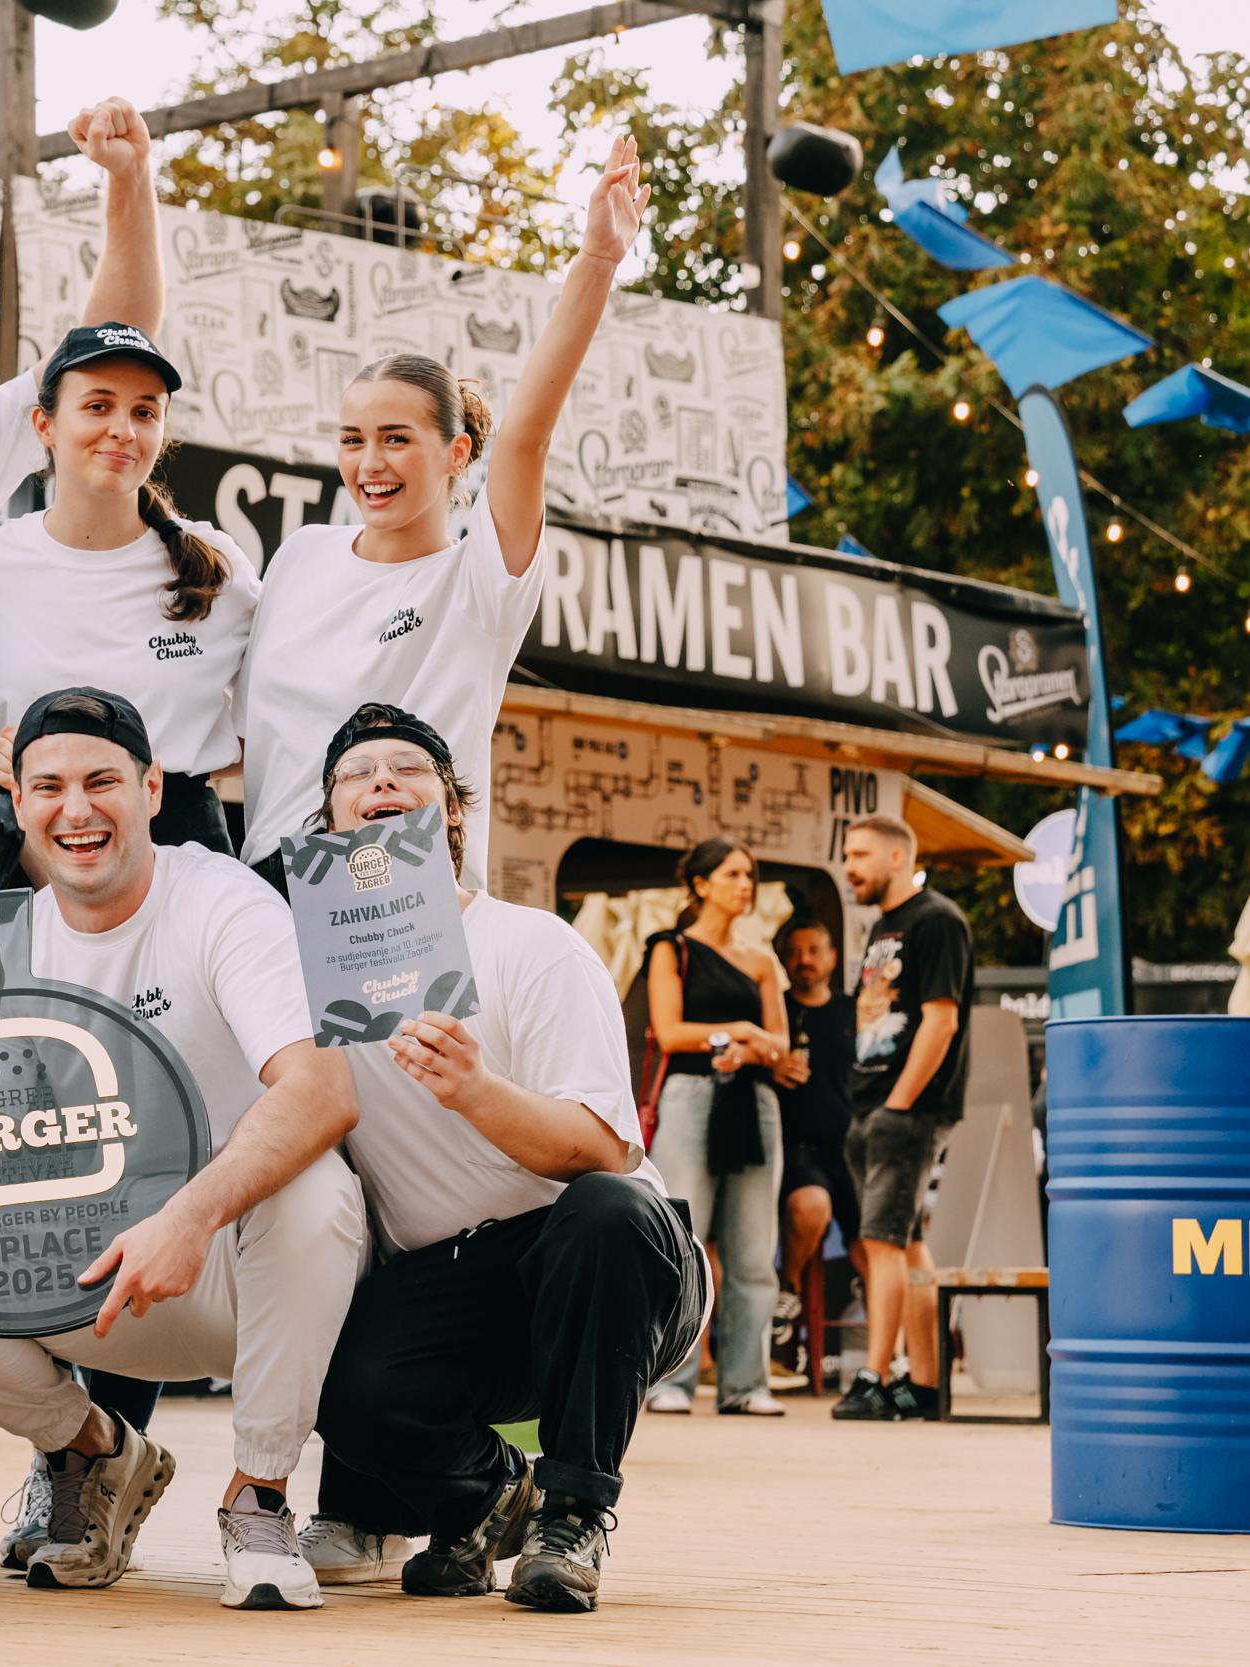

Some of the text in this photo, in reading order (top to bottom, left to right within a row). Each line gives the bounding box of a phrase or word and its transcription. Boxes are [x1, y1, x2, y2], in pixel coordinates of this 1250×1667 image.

[148, 632, 197, 649] Chubby
[824, 582, 959, 718] BAR
[831, 767, 878, 815] PIVO
[349, 855, 390, 874] BURGER
[360, 868, 383, 877] FESTIVAL
[356, 874, 391, 891] ZAGREB
[328, 891, 426, 927] ZAHVALNICA
[349, 922, 416, 945] Chubby Chuck
[325, 930, 444, 964] za sudjelovanje na 10. izdanju
[339, 943, 434, 972] Burger festivala Zagreb
[361, 970, 421, 994] Chubby
[371, 982, 419, 1005] Chuck
[39, 1207, 61, 1223] BY
[65, 1200, 129, 1219] PEOPLE
[0, 1226, 103, 1263] PLACE
